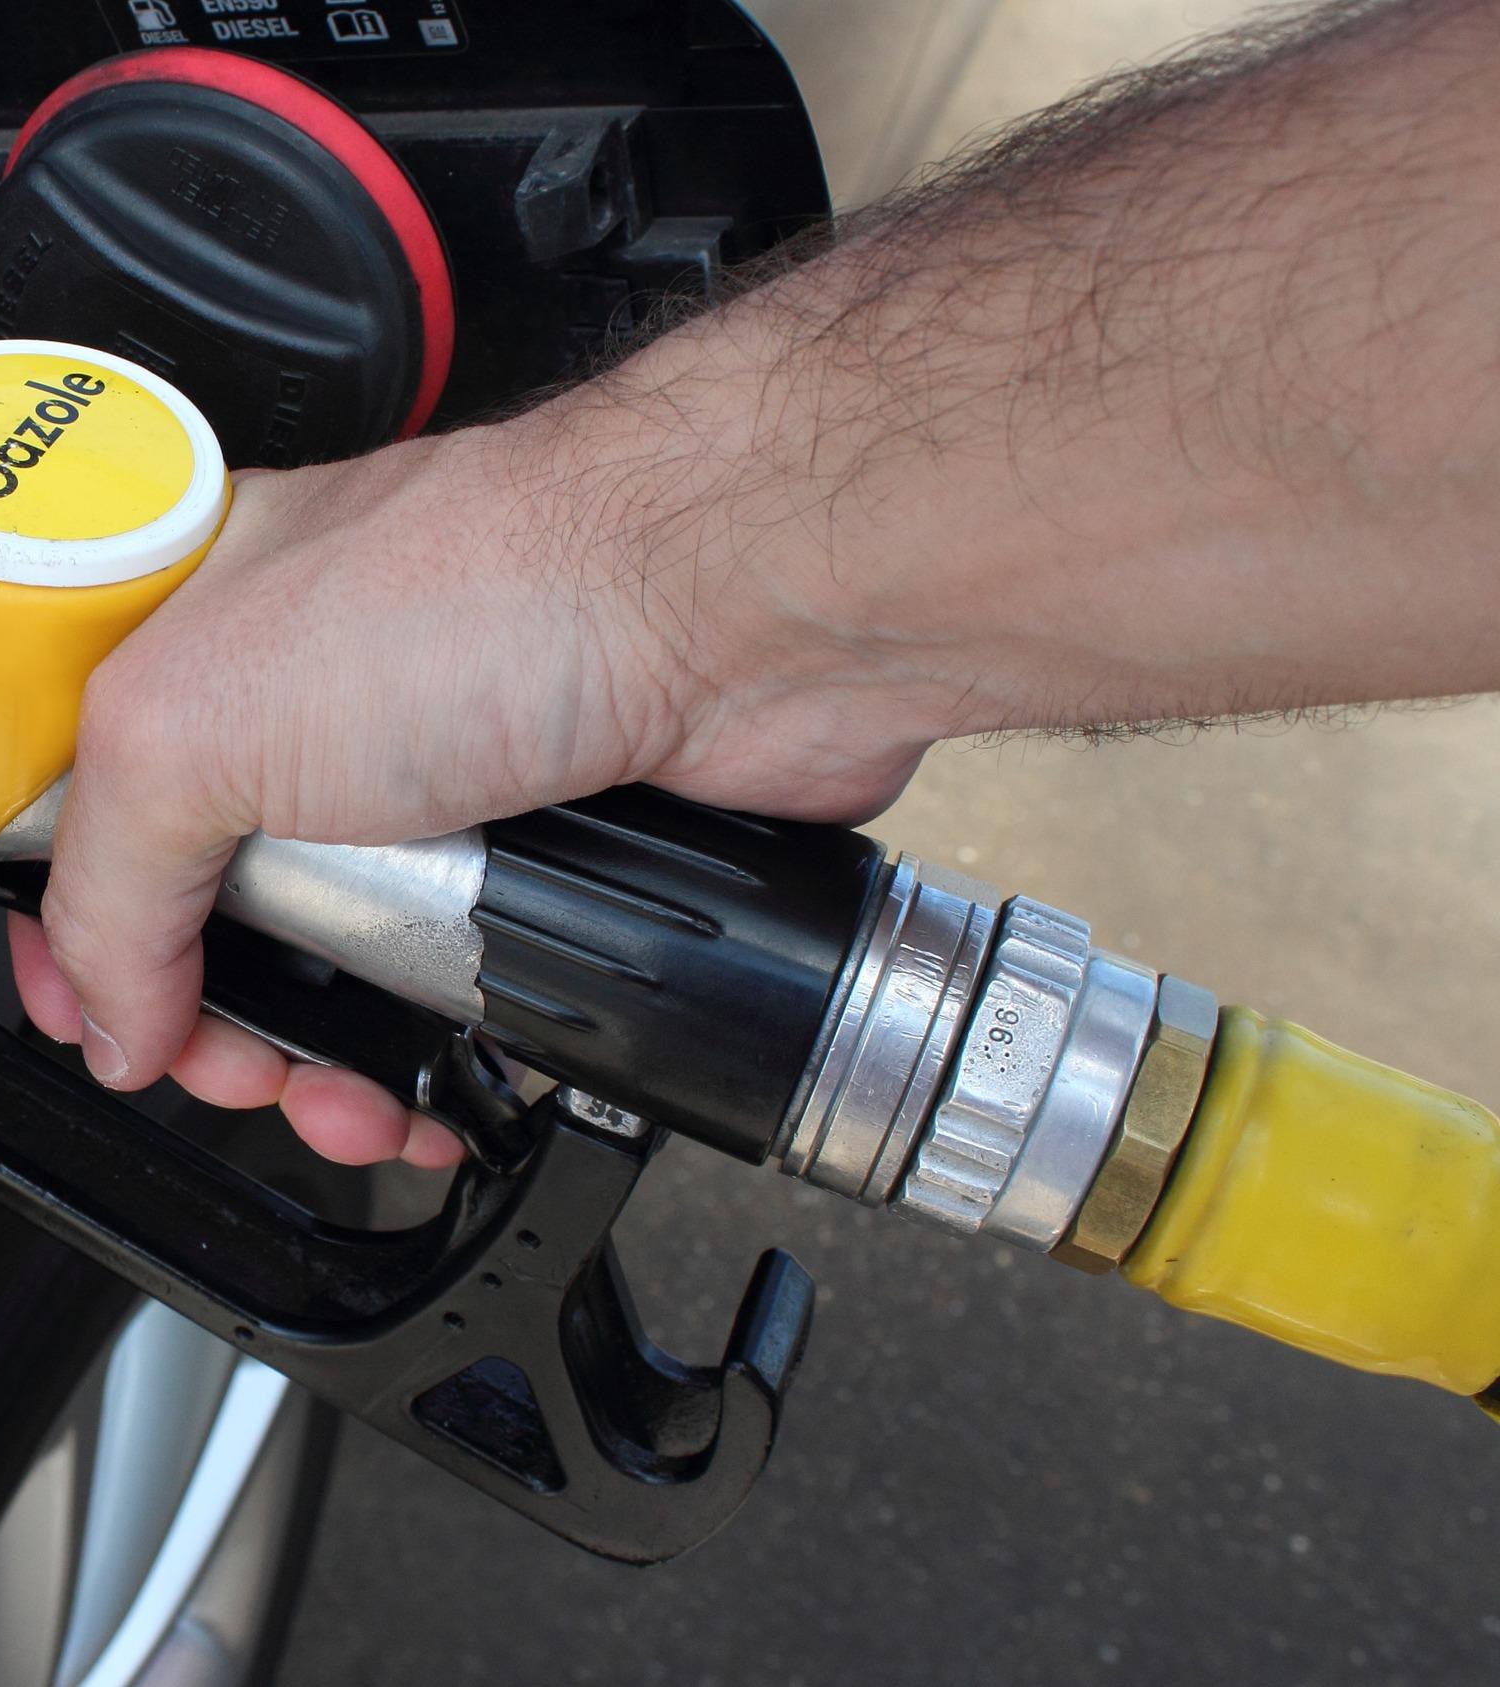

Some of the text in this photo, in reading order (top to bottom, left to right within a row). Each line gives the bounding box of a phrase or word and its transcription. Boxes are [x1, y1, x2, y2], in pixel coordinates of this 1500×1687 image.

[141, 30, 190, 45] DIESEL
[212, 17, 300, 41] DIESEL
[989, 1008, 1019, 1044] 96
